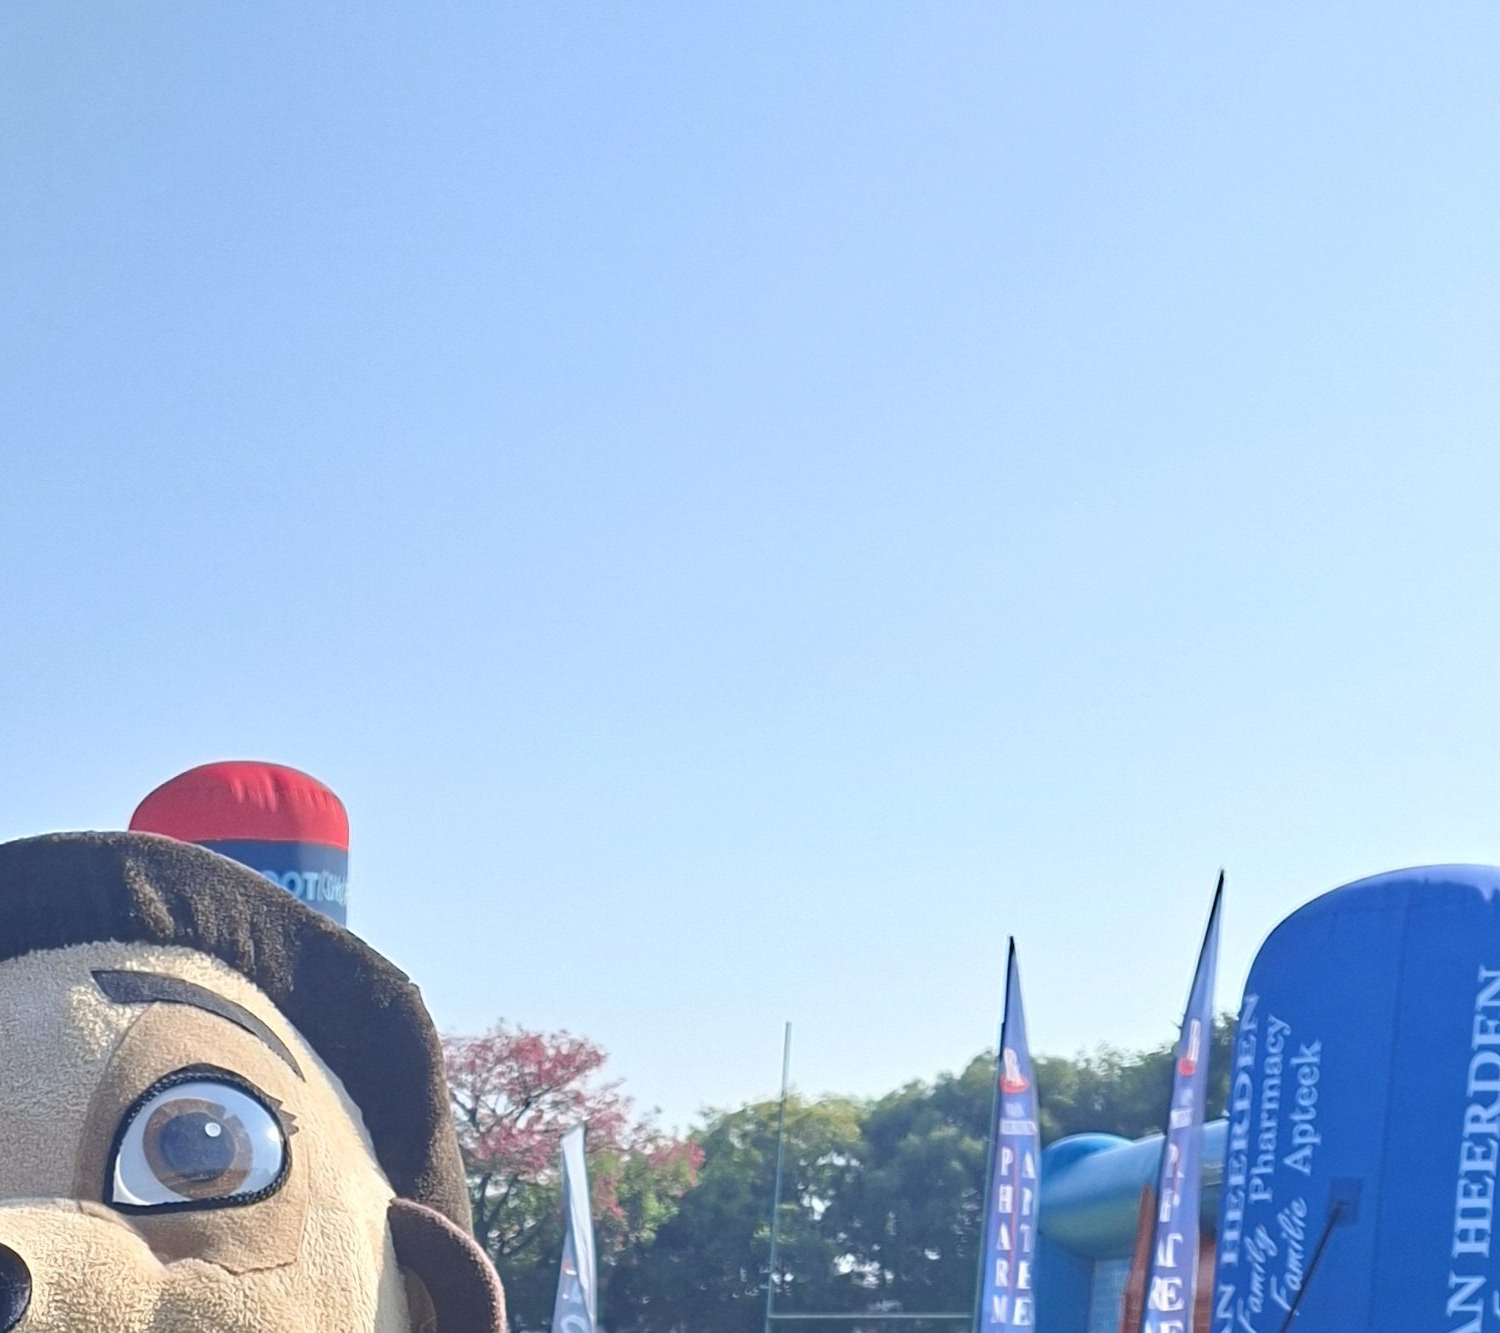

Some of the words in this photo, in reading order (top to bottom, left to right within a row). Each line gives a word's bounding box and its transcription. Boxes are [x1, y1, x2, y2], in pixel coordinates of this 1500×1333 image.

[1221, 993, 1259, 1267] HEERDEN
[1250, 1014, 1291, 1203] Pharmacy
[1283, 1039, 1322, 1175] Apteek
[1452, 964, 1500, 1258] HEERDEN
